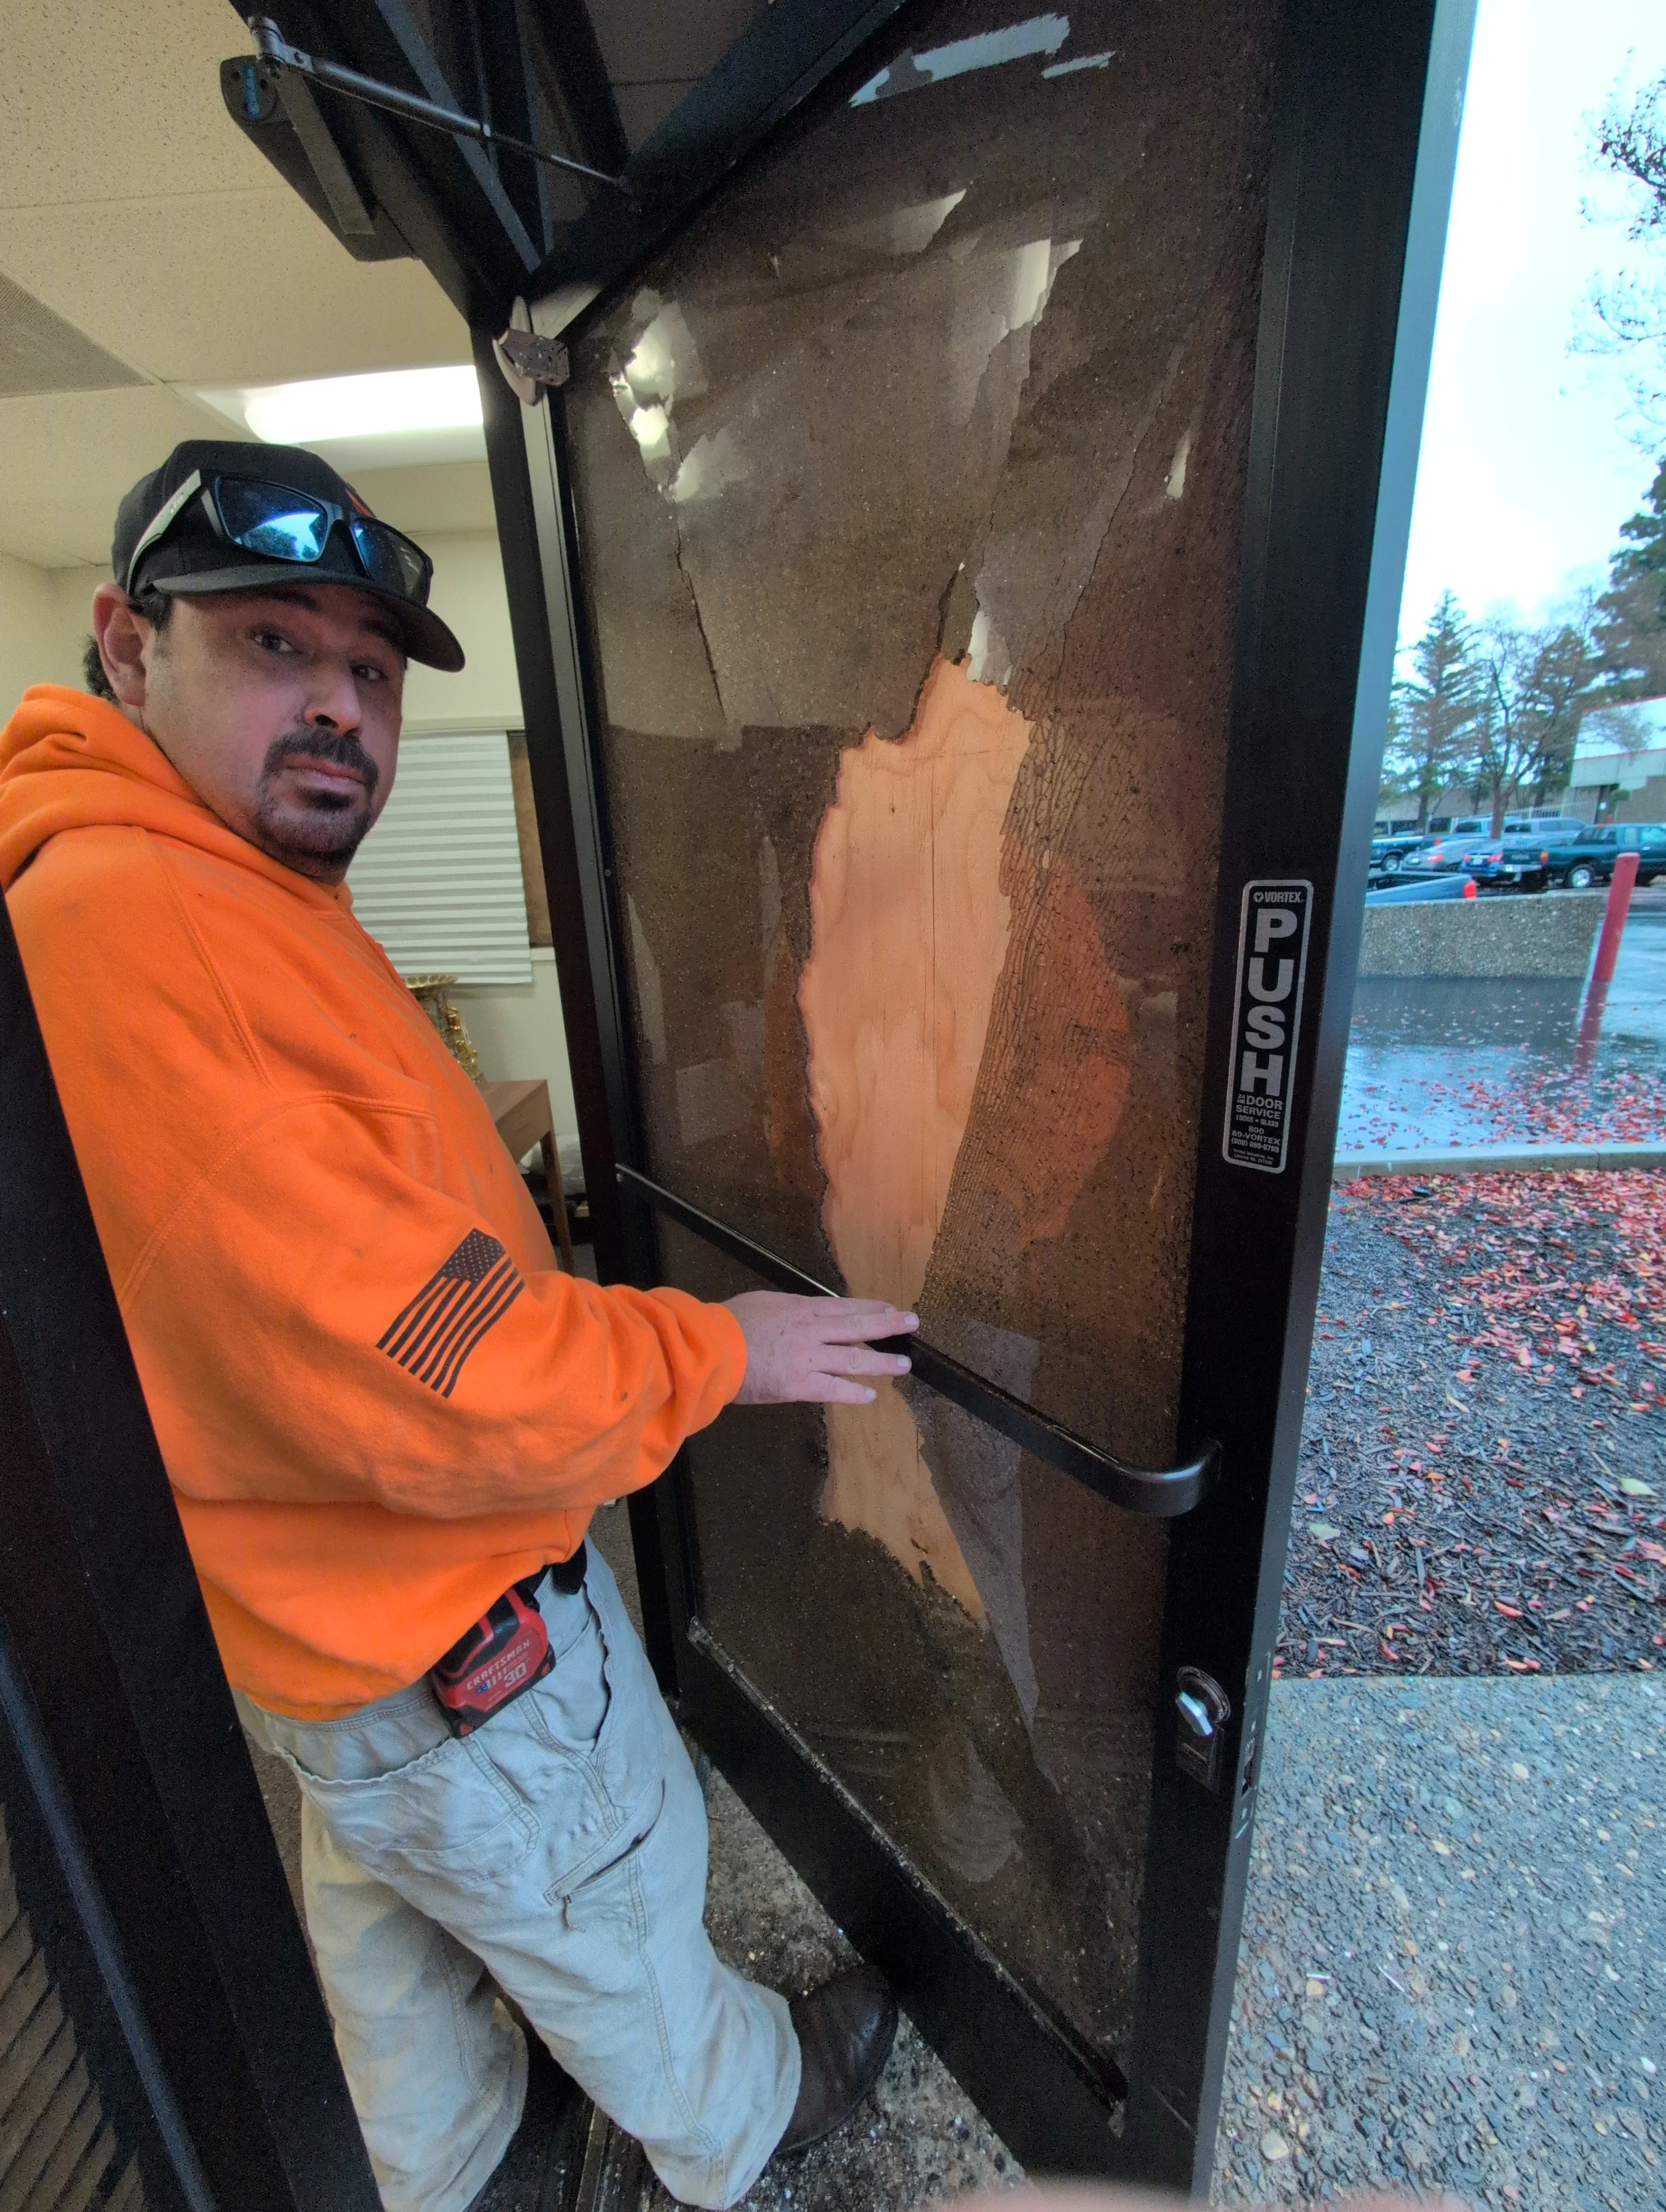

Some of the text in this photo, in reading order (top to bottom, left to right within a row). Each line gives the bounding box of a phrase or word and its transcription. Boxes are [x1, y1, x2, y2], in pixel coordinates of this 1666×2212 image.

[1265, 891, 1301, 903] VORTEX
[1240, 908, 1297, 1097] PUSH
[1246, 1095, 1283, 1111] DOOR
[1236, 1105, 1281, 1119] SERVICE
[1248, 1126, 1264, 1135] 800
[467, 1639, 530, 1690] CRAFTSMAN
[504, 1662, 527, 1688] 30
